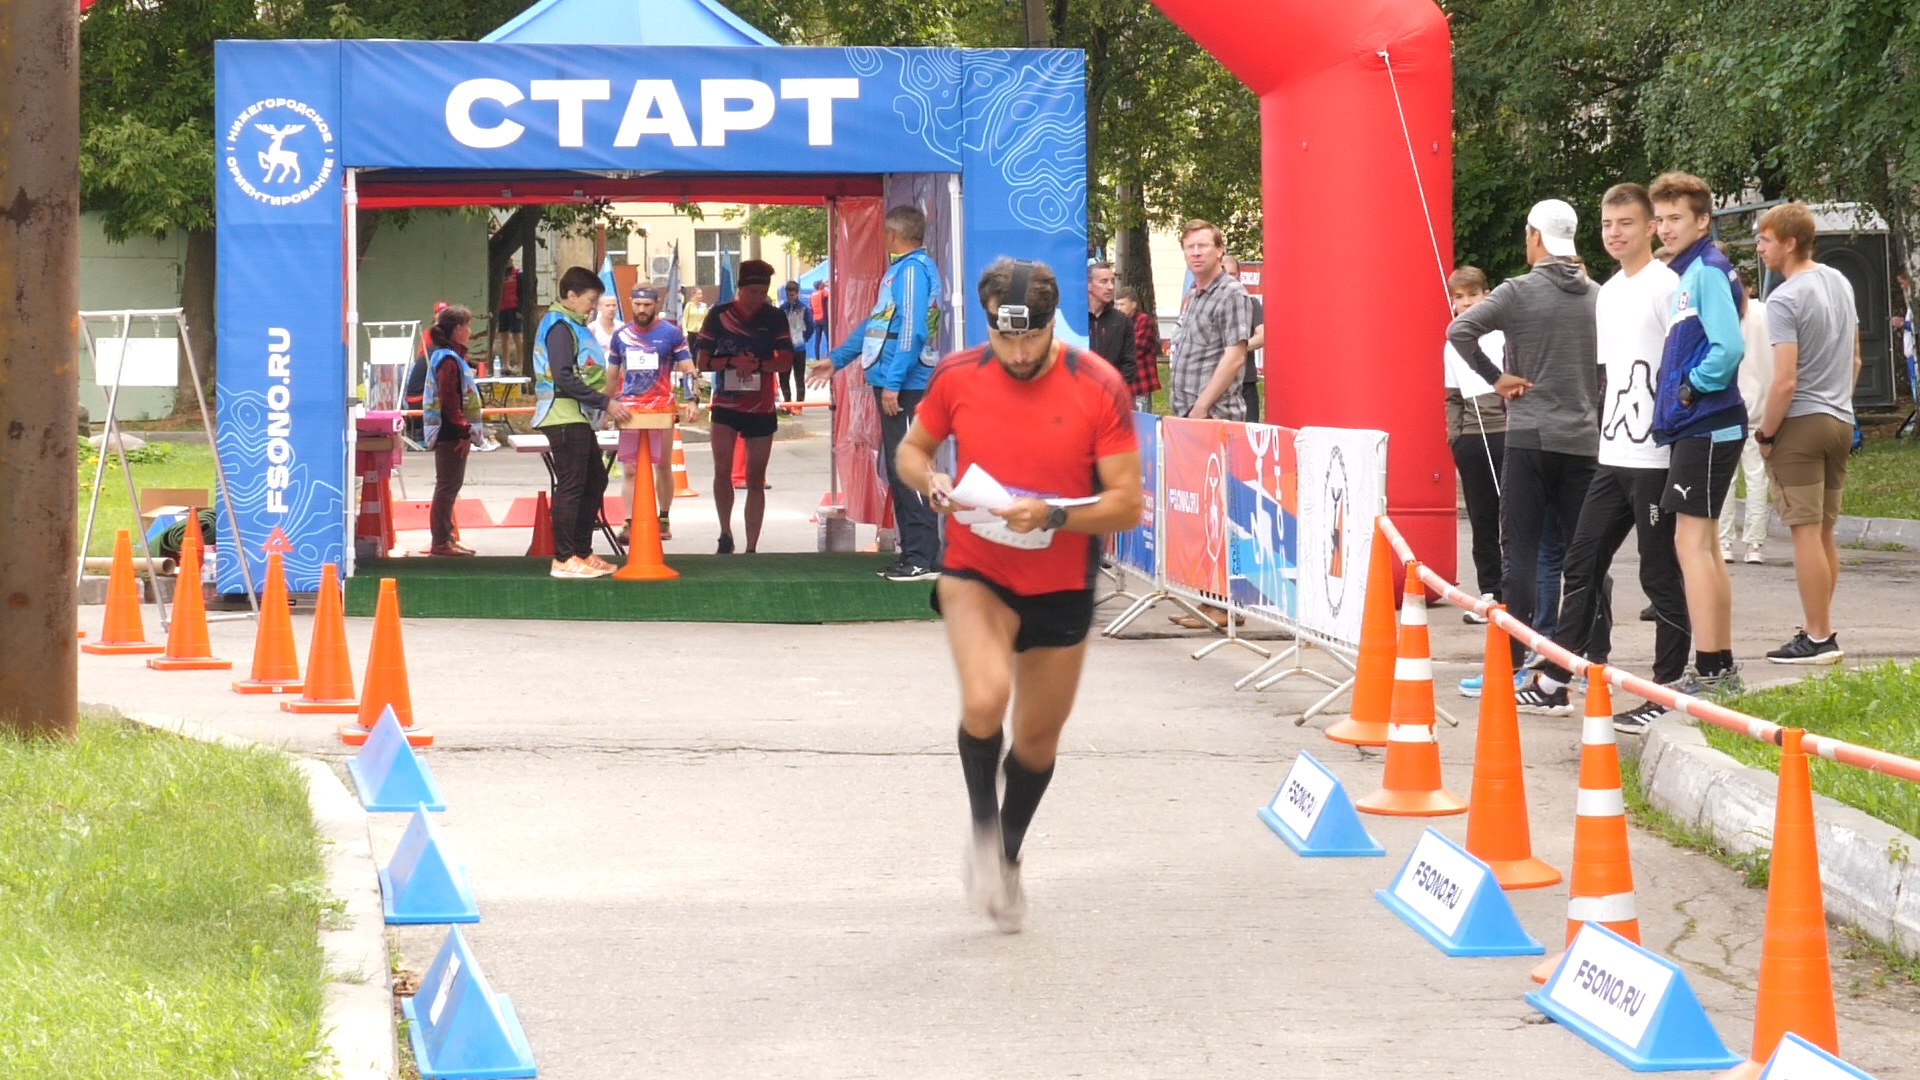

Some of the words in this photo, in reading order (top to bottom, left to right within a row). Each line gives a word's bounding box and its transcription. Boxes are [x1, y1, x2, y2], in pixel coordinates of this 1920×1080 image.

[227, 98, 333, 143] НИЖЕГОРОДСКОЕ
[446, 78, 860, 148] СТАРТ
[226, 156, 334, 206] ОРИЕНТИРОВАНИЕ
[639, 355, 646, 365] 5
[267, 327, 291, 513] FSONO.RU
[1286, 780, 1318, 818] FSONO.RU
[1412, 861, 1463, 910] FSONO.RU
[1573, 959, 1647, 1017] FSONO.RU
